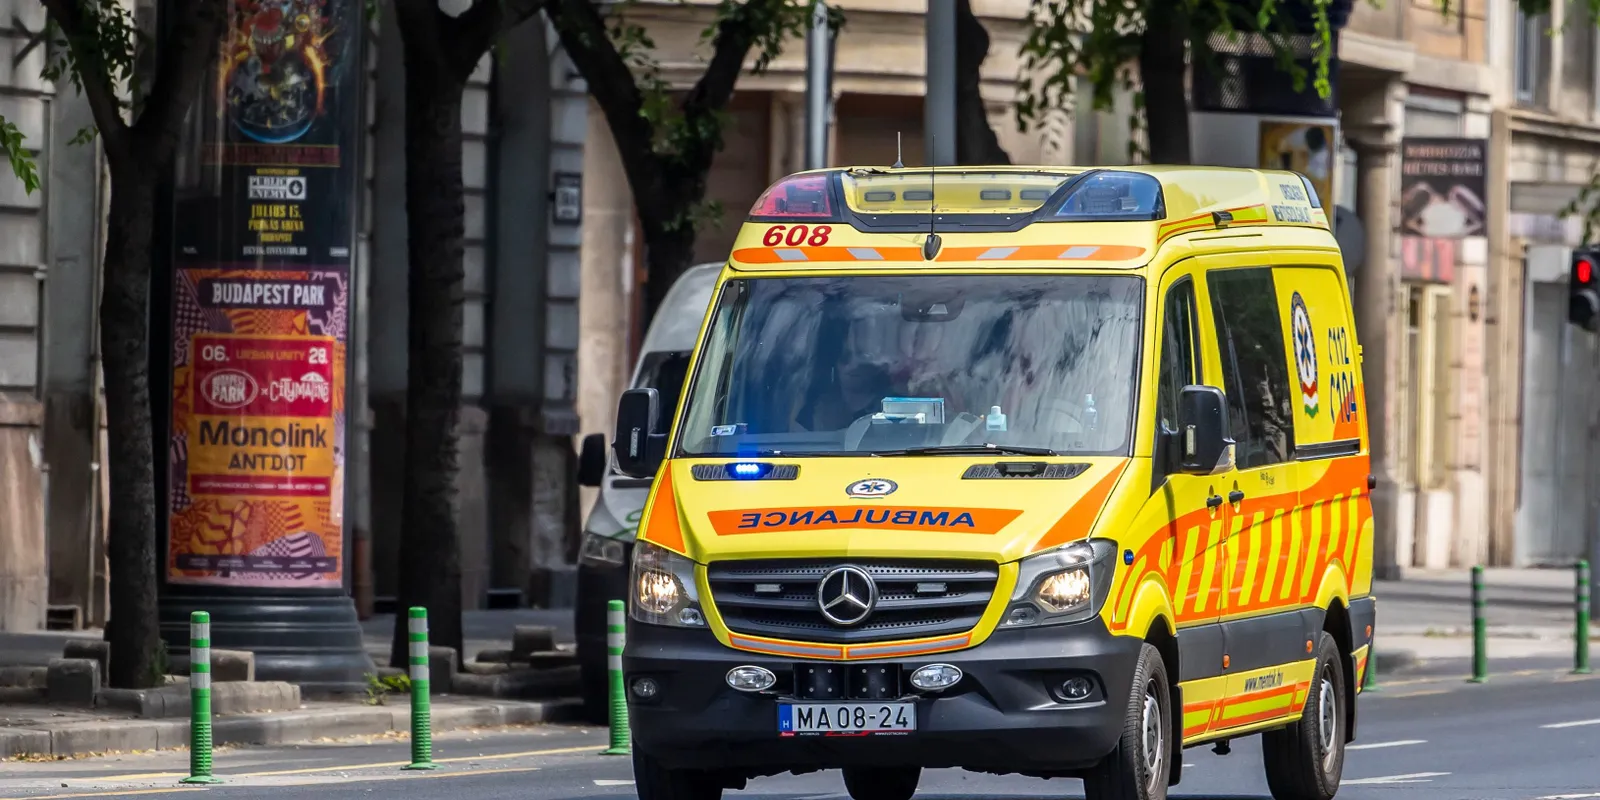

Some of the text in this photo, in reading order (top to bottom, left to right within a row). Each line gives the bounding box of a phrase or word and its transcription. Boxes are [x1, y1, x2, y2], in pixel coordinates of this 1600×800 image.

[251, 189, 287, 199] ENEMY
[762, 225, 832, 247] 608
[212, 283, 325, 305] BUDAPEST PARK
[202, 346, 230, 361] 06.
[1333, 326, 1350, 365] 112
[235, 350, 305, 361] URBAN UNITY
[308, 347, 328, 364] 28.
[211, 385, 246, 402] PARK
[1336, 371, 1358, 423] 104
[199, 420, 327, 448] Monolink
[228, 453, 307, 471] ANTDOT
[783, 720, 790, 728] H
